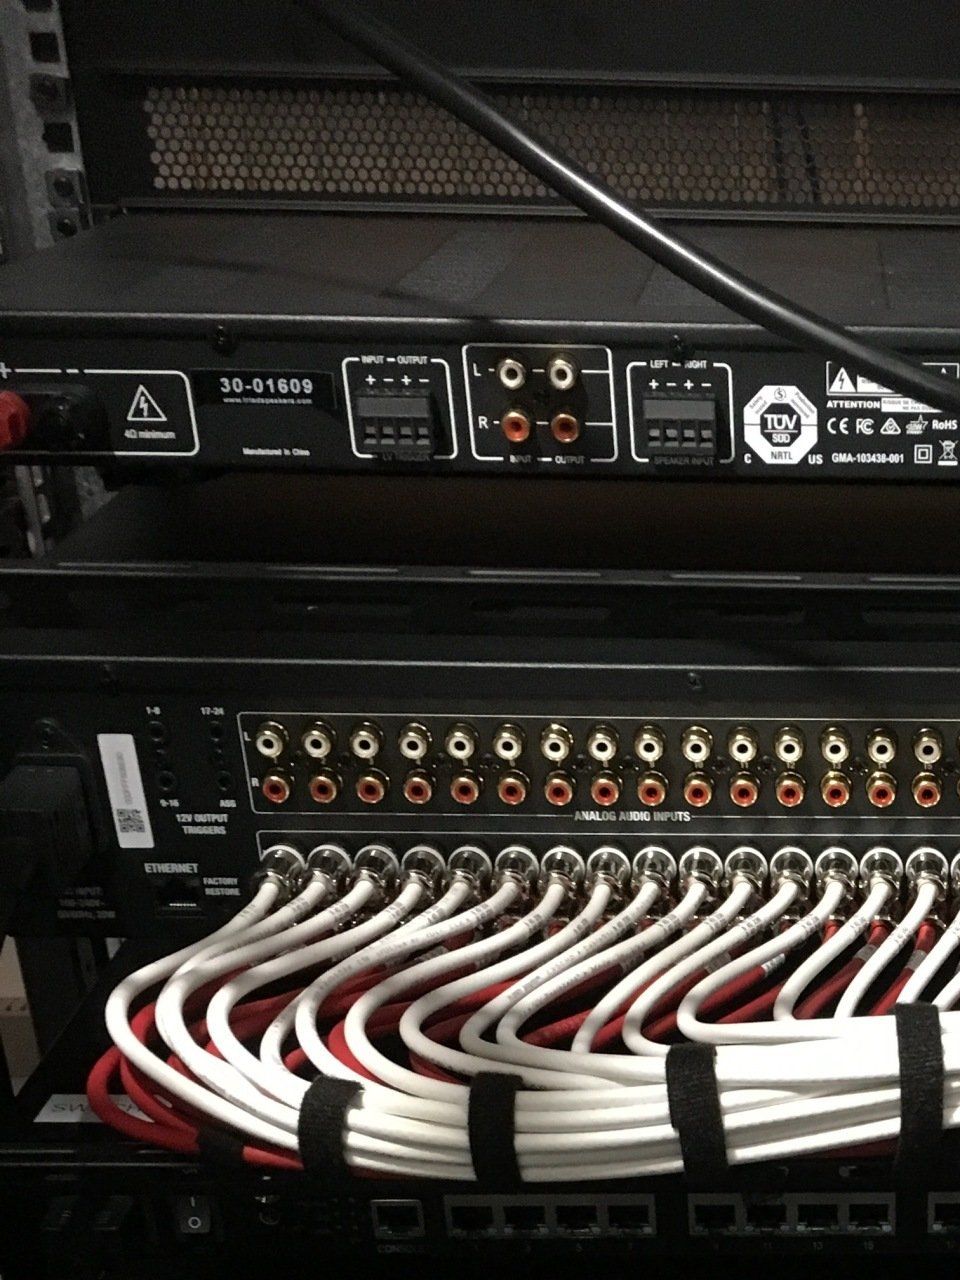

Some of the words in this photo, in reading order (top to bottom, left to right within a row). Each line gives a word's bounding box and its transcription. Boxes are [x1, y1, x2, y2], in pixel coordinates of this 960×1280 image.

[361, 355, 384, 364] INPUT
[396, 355, 428, 364] OUTPUT
[650, 360, 669, 368] LEFT
[684, 360, 708, 369] RIGHT
[473, 363, 482, 377] L
[220, 377, 313, 394] 30-01609
[826, 400, 881, 409] ATTENTION
[478, 416, 489, 429] R
[764, 413, 798, 429] TÜV
[932, 420, 958, 431] RoHS
[555, 455, 585, 464] OUTPUT
[771, 451, 793, 460] NRTL
[808, 454, 823, 465] US
[574, 811, 617, 822] ANALOG
[619, 811, 651, 822] AUDIO
[653, 811, 691, 822] INPUTS
[144, 863, 199, 874] ETHERNET
